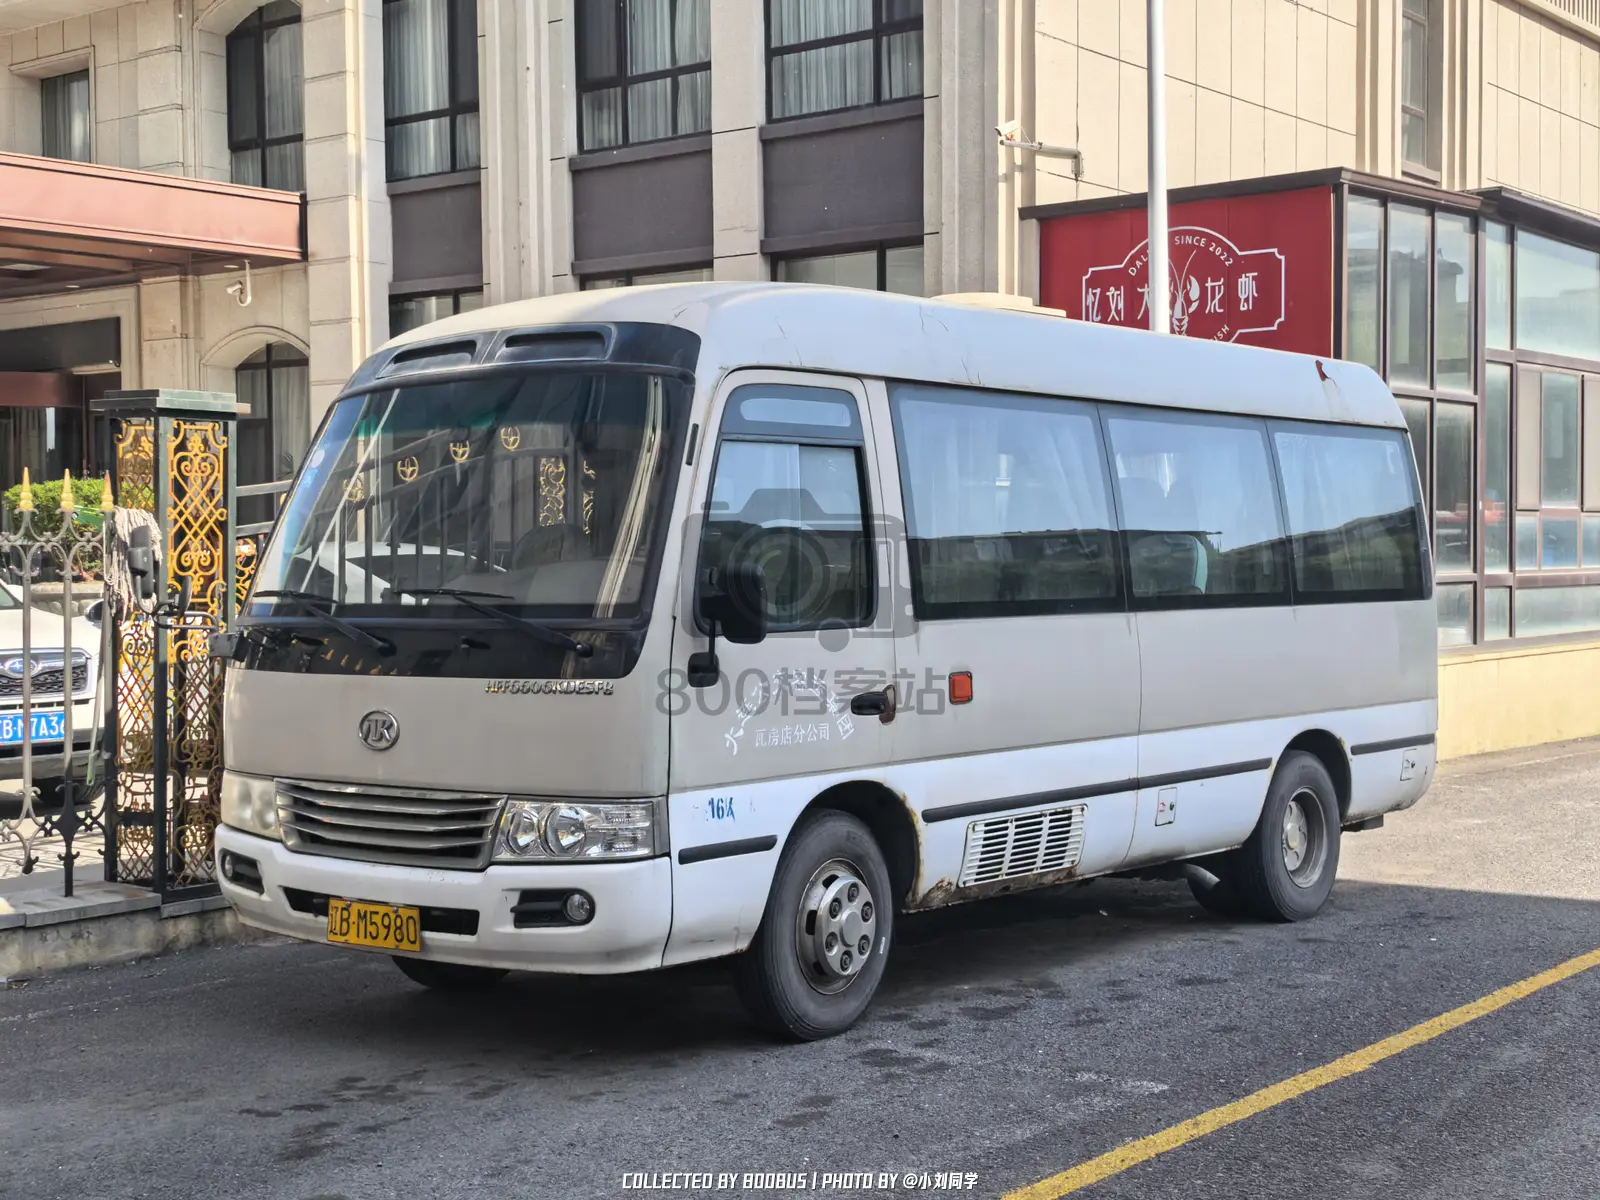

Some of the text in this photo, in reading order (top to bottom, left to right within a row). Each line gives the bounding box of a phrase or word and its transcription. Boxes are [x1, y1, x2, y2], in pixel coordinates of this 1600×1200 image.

[1128, 248, 1150, 276] DAL
[1174, 235, 1233, 267] SINCE 2022
[755, 722, 830, 747] 瓦房店分公司
